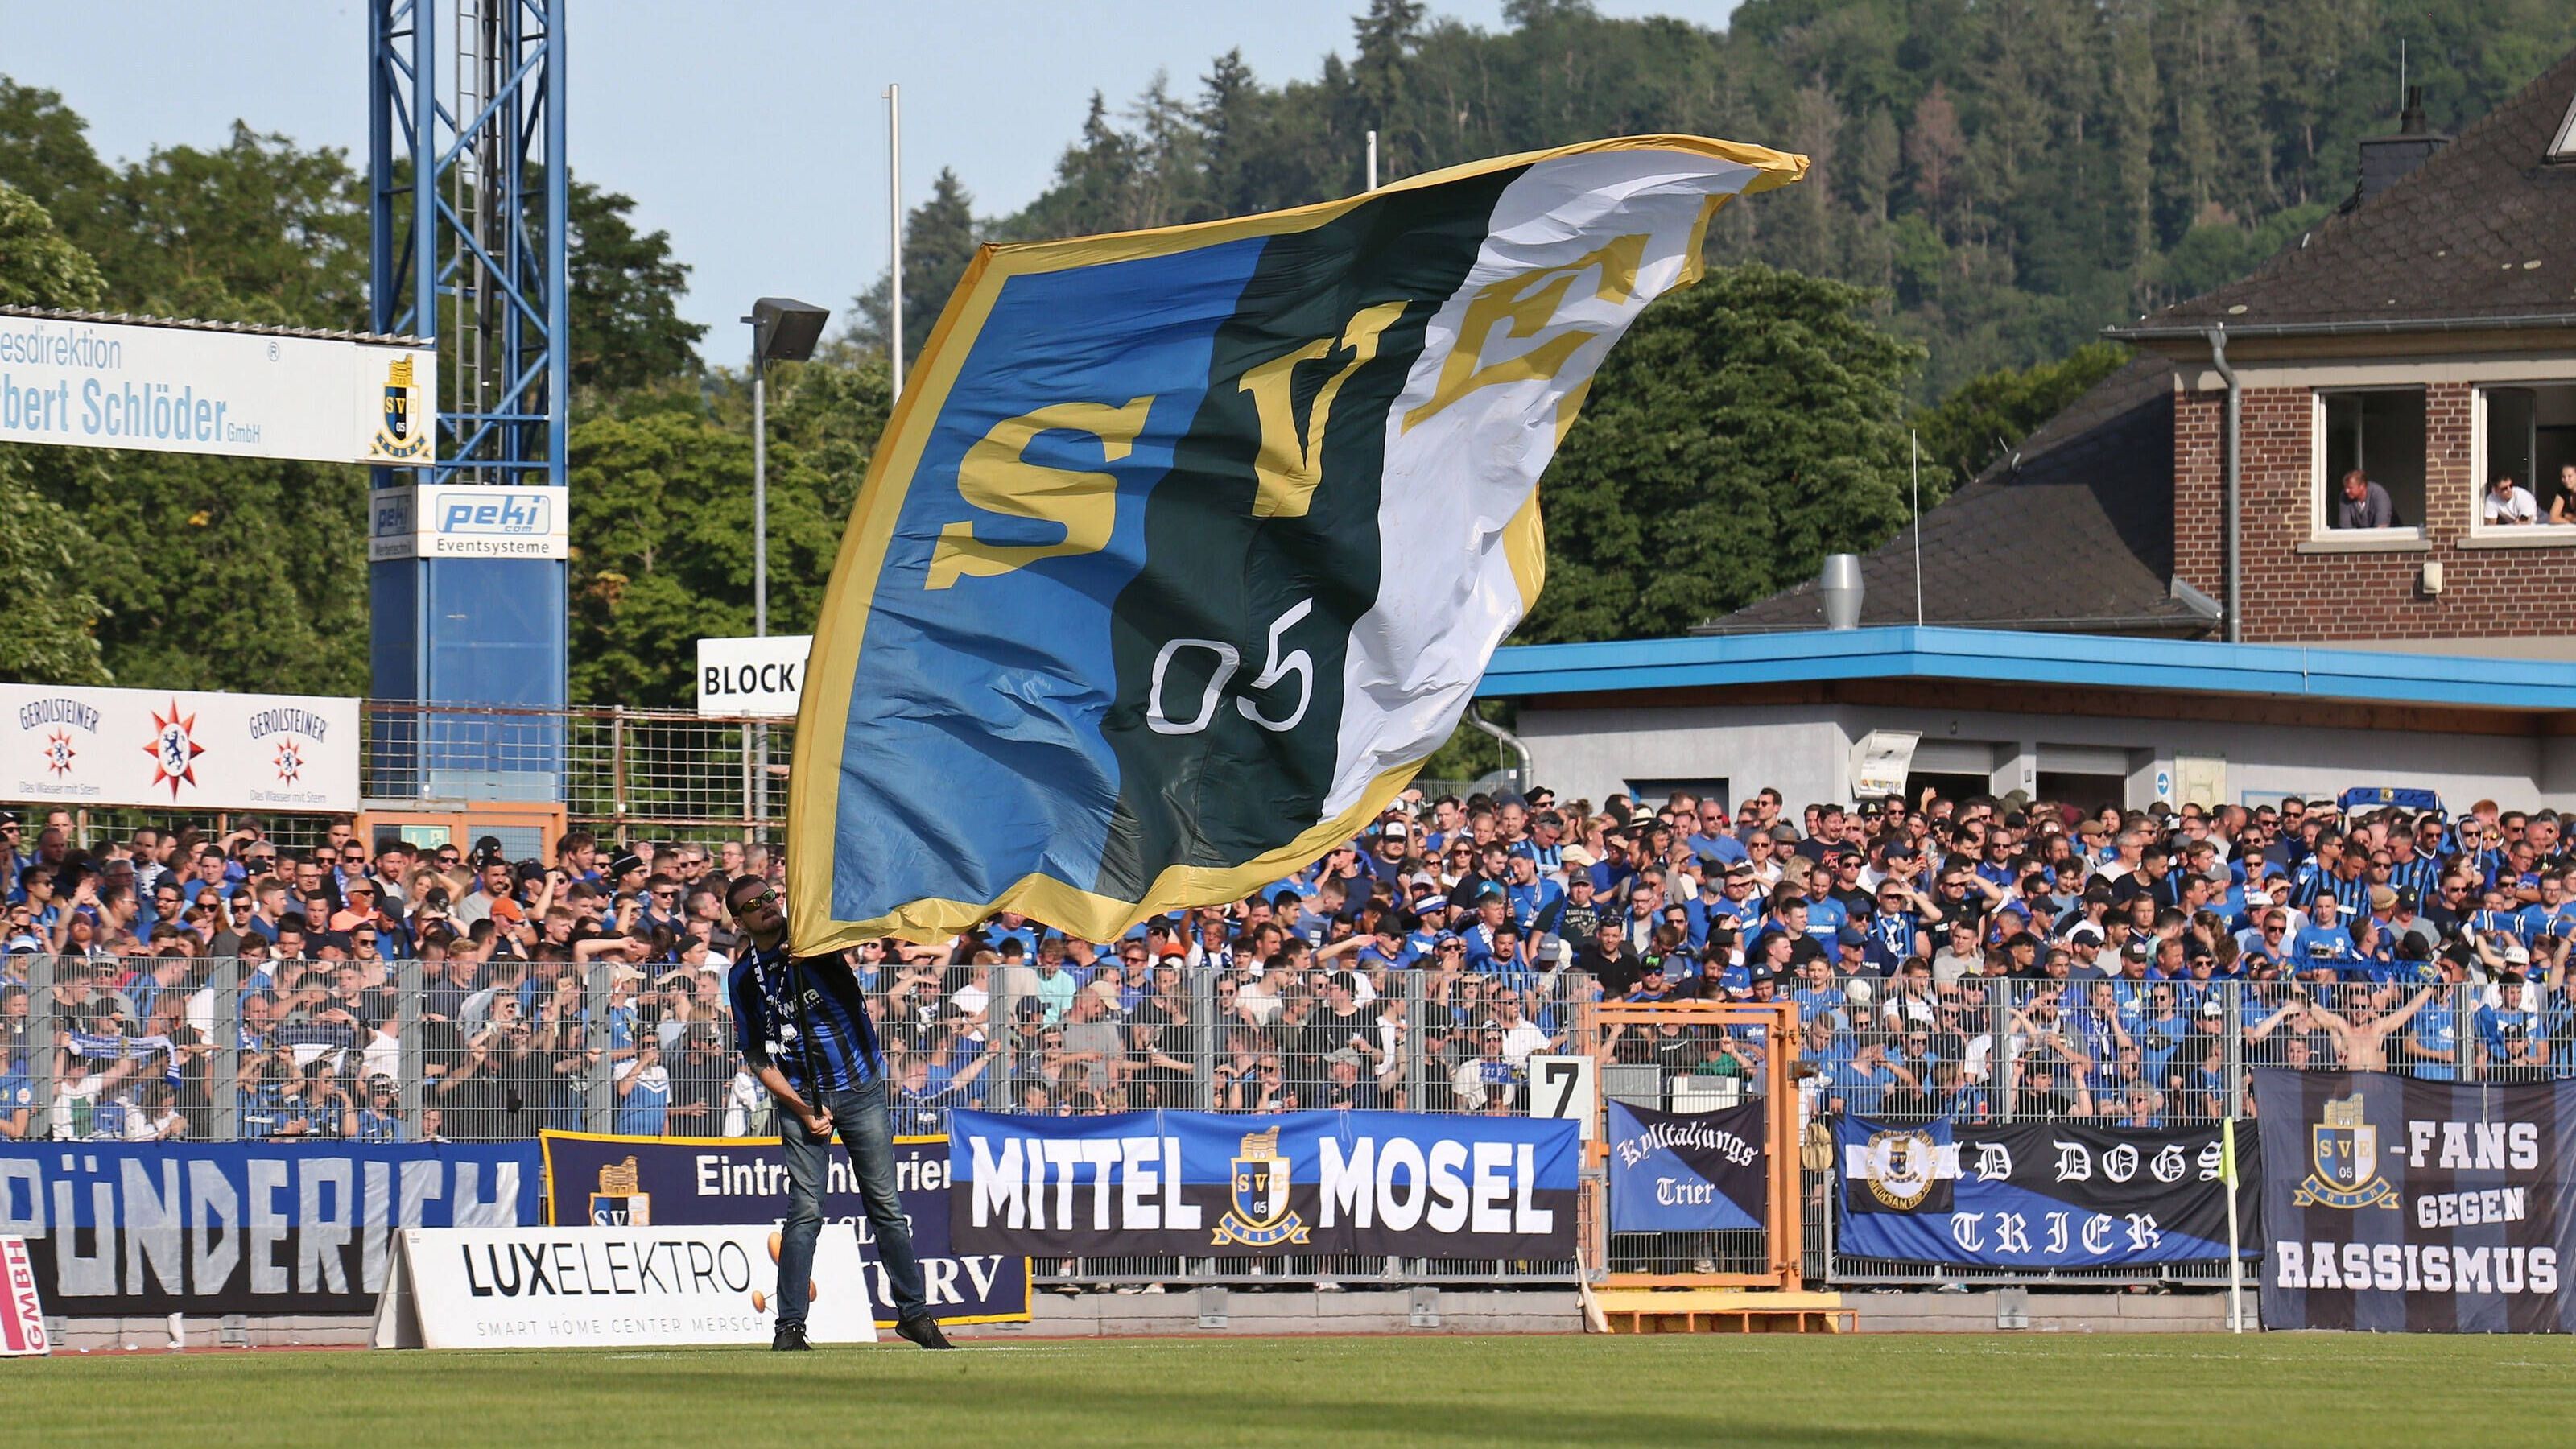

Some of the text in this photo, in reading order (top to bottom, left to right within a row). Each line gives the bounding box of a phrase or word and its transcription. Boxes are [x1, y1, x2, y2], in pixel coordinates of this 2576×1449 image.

[0, 374, 261, 444] bert Schlöder GmbH
[444, 496, 540, 533] peki
[437, 538, 550, 556] Eventsysteme
[705, 663, 796, 696] BLOCK
[1146, 597, 1314, 735] 05
[19, 698, 99, 734] GEROLSTEINER
[250, 708, 327, 743] GEROLSTEINER
[19, 780, 101, 796] Das Wasser mit Stern
[250, 789, 327, 804] Das Wasser mit Stern
[1546, 1063, 1579, 1119] 7
[2320, 1139, 2370, 1158] SVE
[696, 1151, 952, 1196] Eintrht rier
[968, 1136, 1203, 1231] MITTEL
[1237, 1173, 1284, 1193] SVE
[1318, 1136, 1554, 1234] MOSEL
[2339, 1166, 2353, 1179] 05
[1253, 1200, 1268, 1214] 05
[1656, 1176, 1716, 1207] Trier
[2312, 1185, 2379, 1207] TRIER
[2417, 1187, 2526, 1229] GEGEN
[1228, 1221, 1292, 1241] TRIER
[1950, 1210, 2161, 1255] TRIER
[461, 1240, 750, 1297] LUXELEKTRO
[2277, 1241, 2558, 1294] RASSISMUS
[6, 1241, 45, 1351] GMBH
[477, 1315, 765, 1337] SMART HOME CENTER MERSCH
